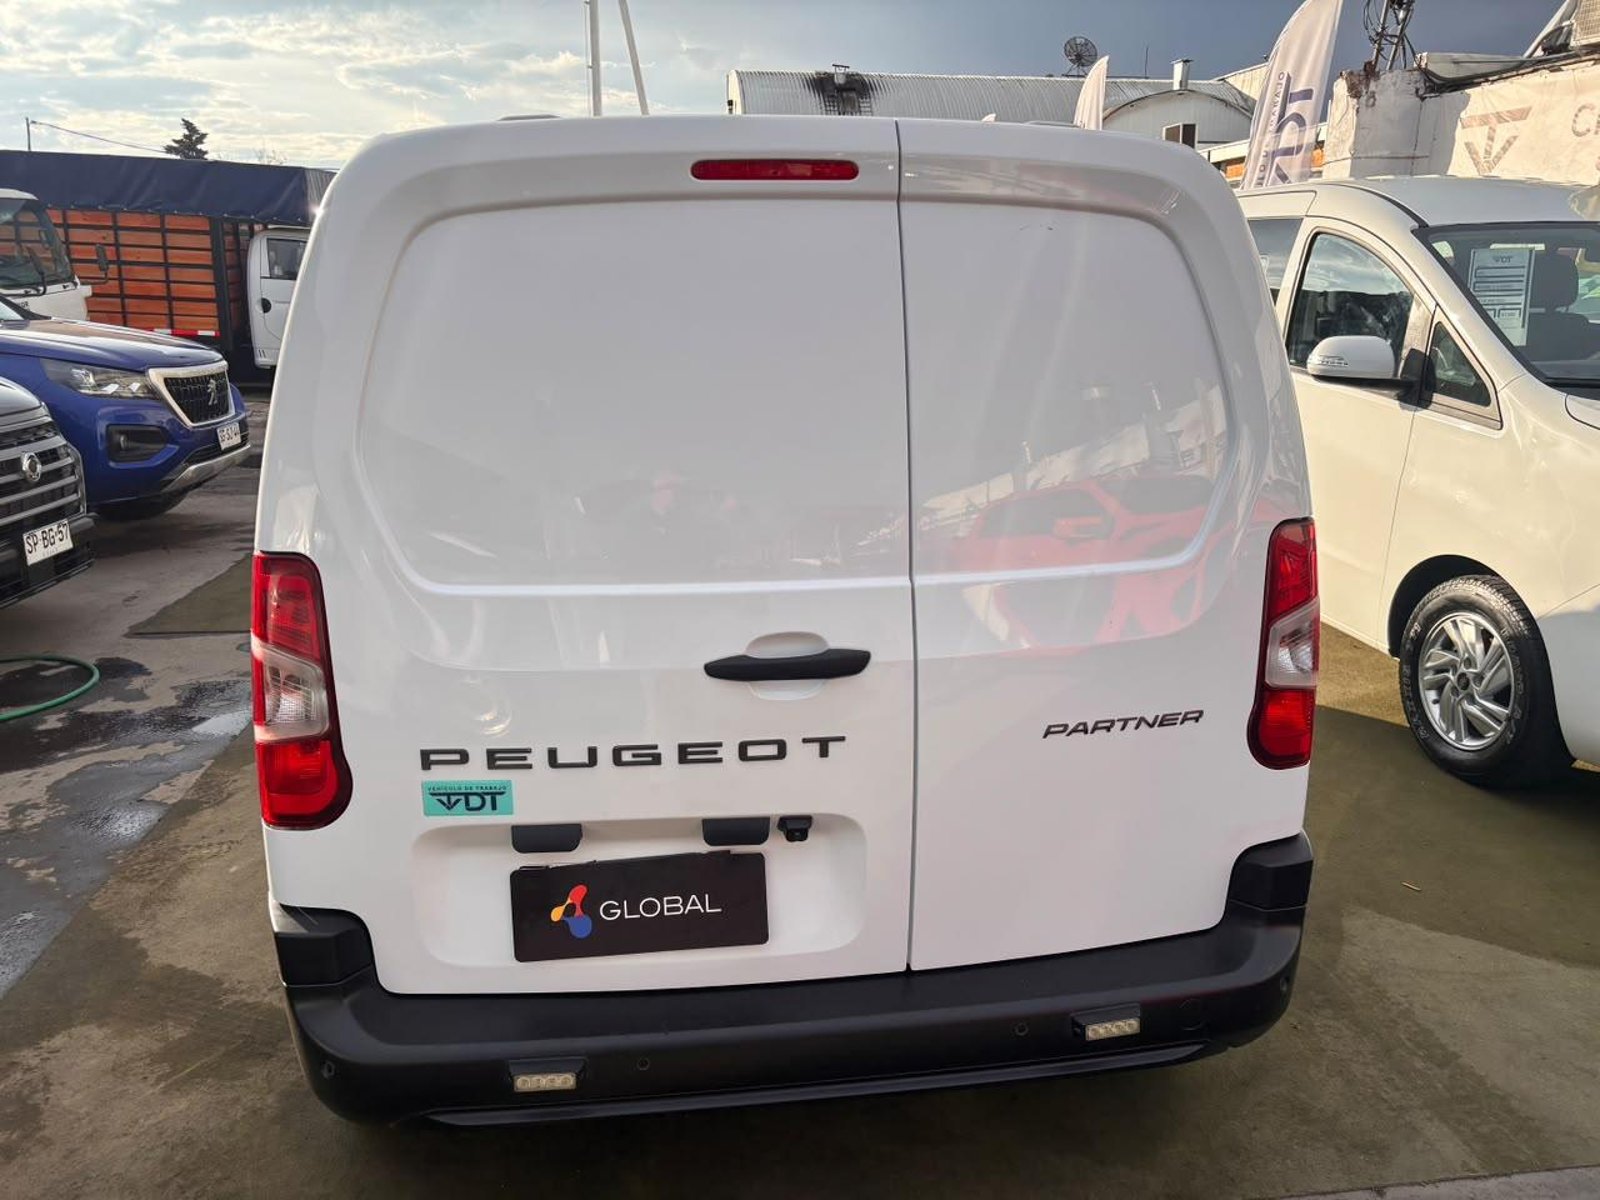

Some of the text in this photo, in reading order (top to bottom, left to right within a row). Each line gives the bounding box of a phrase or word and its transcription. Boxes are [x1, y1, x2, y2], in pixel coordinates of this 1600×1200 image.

[1042, 709, 1204, 739] PARTNER
[420, 735, 846, 771] PEUGEOT
[599, 893, 722, 921] GLOBAL
